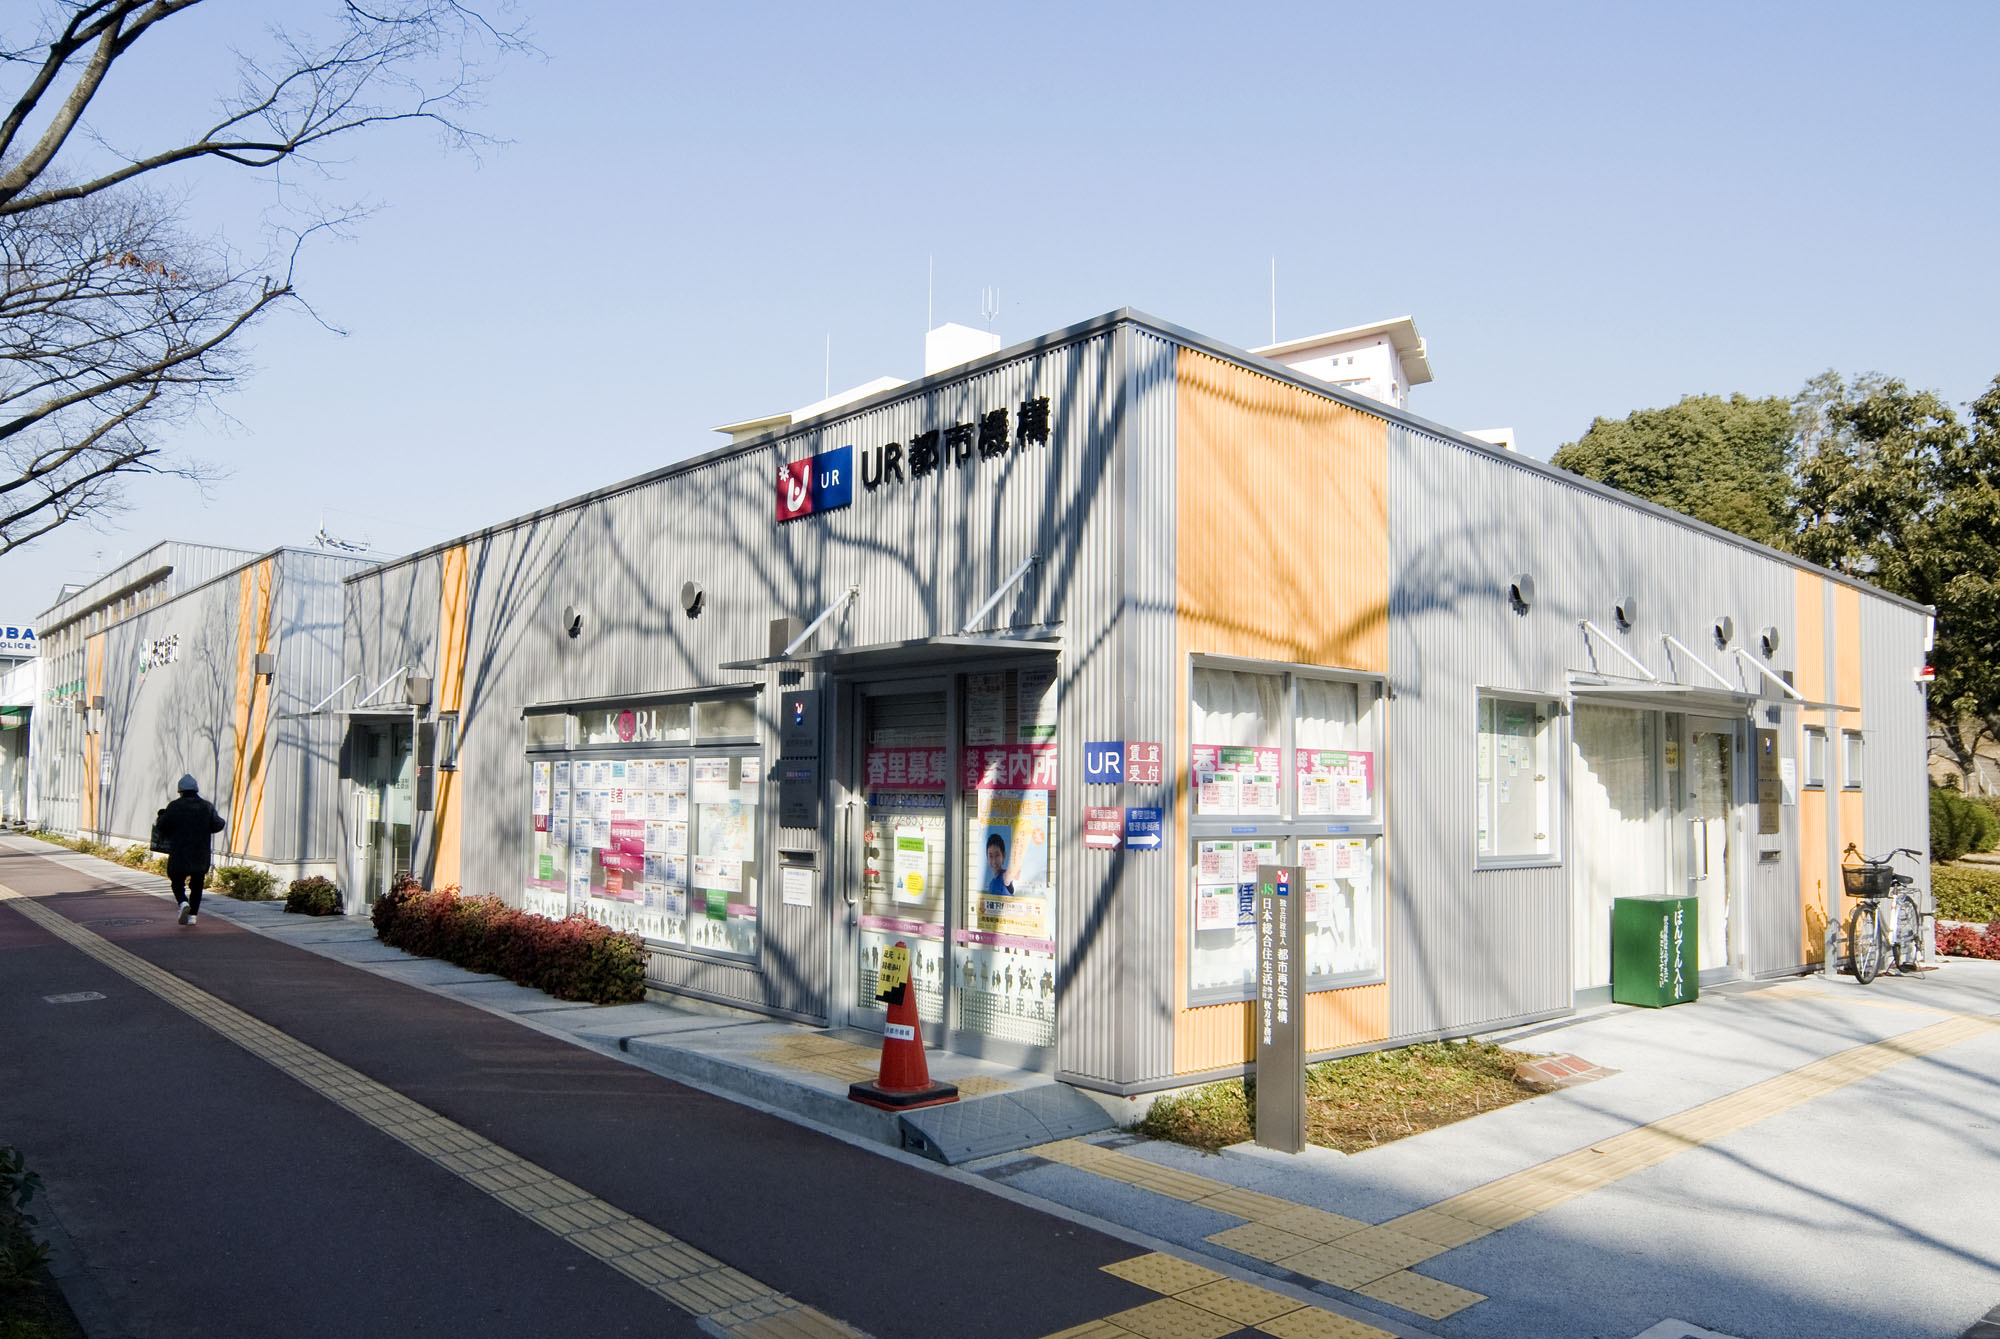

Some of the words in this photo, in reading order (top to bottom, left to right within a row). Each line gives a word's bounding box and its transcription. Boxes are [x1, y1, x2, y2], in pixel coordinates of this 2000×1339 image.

[821, 469, 840, 489] UR
[0, 627, 36, 640] BA
[1087, 751, 1121, 774] UR
[1129, 744, 1160, 762] 賃貸
[983, 748, 1056, 786] 案内所
[1129, 764, 1160, 782] 受付
[1261, 883, 1274, 895] JS
[1262, 897, 1273, 986] 日本総合住生活
[1277, 948, 1289, 1024] 都市再生機構
